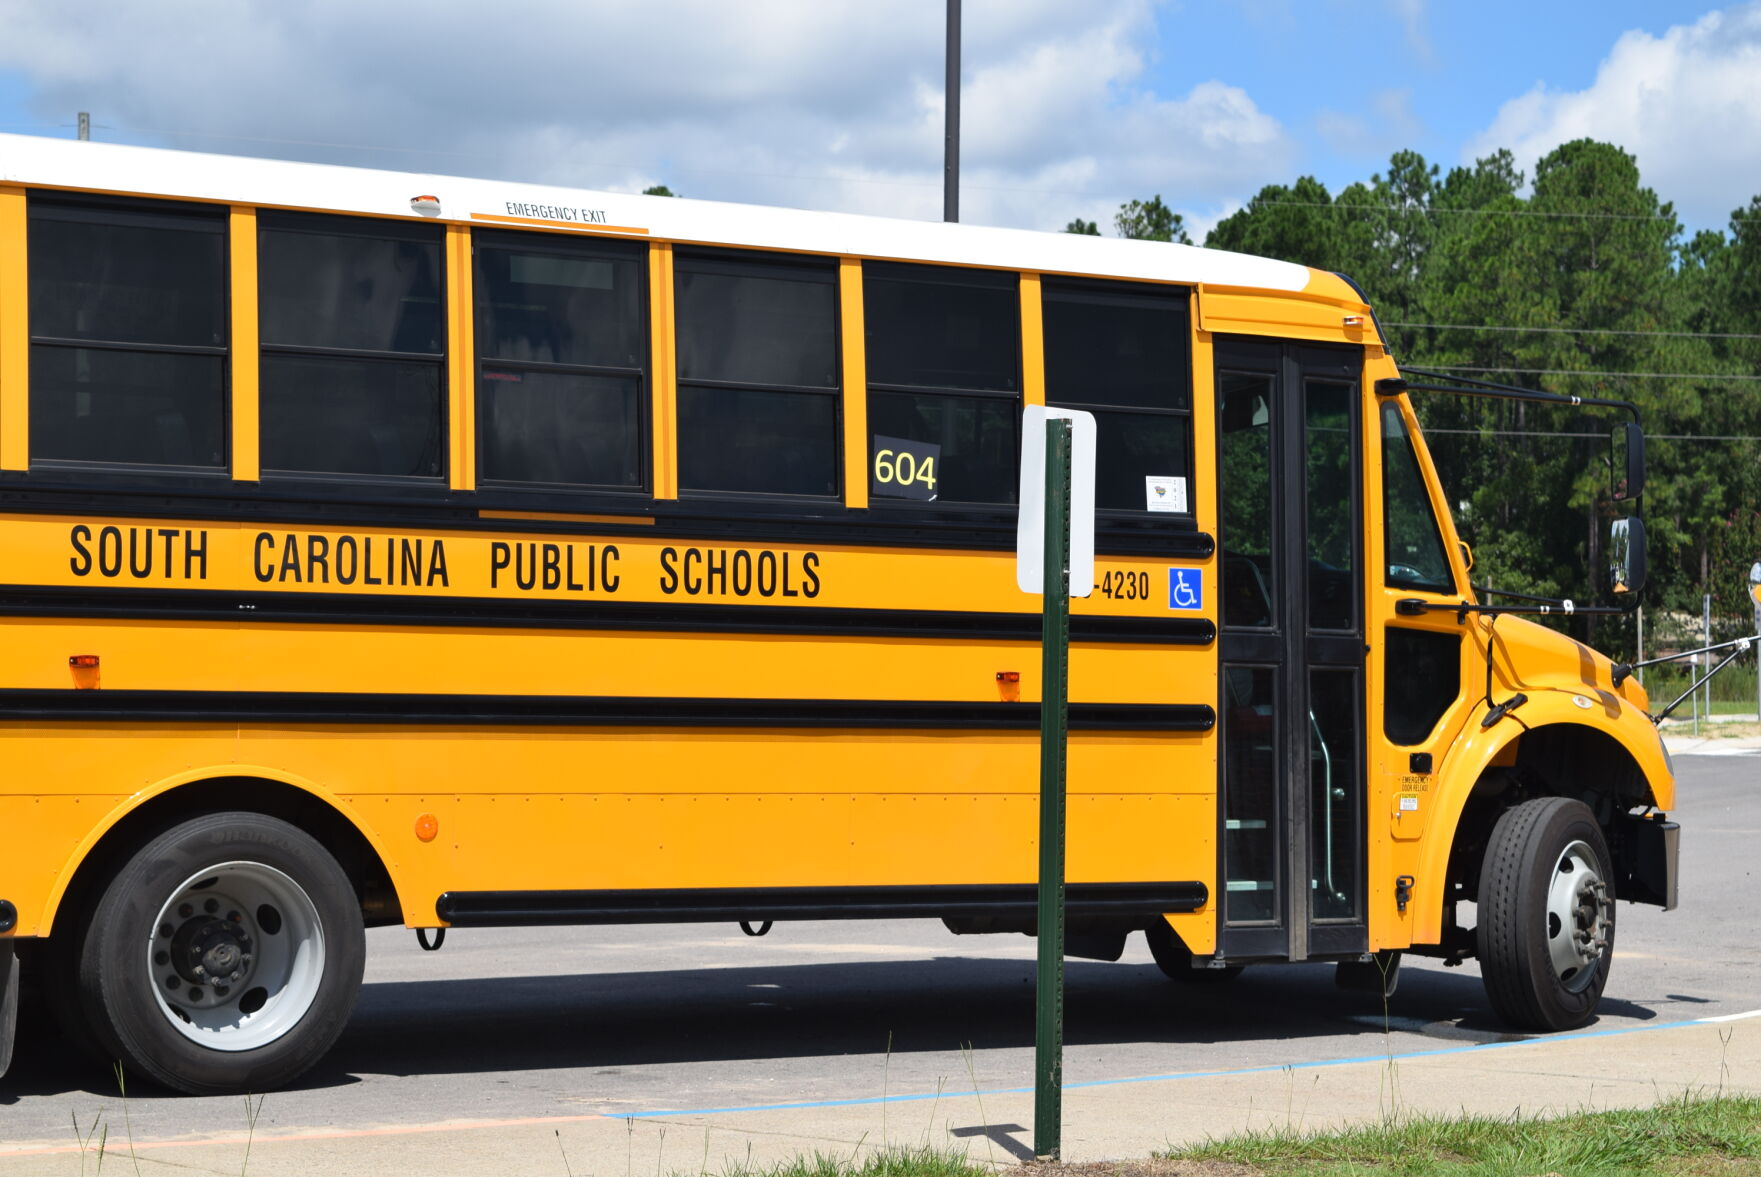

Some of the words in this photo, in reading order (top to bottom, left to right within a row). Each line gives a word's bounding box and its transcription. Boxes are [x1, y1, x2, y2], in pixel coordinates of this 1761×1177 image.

[505, 201, 578, 221] EMERGENCY
[581, 209, 607, 223] EXIT
[875, 449, 937, 490] 604
[69, 524, 208, 580] SOUTH
[253, 532, 449, 588] CAROLINA
[490, 541, 620, 593] PUBLIC
[659, 547, 821, 599] SCHOOLS
[1070, 570, 1149, 601] -4230
